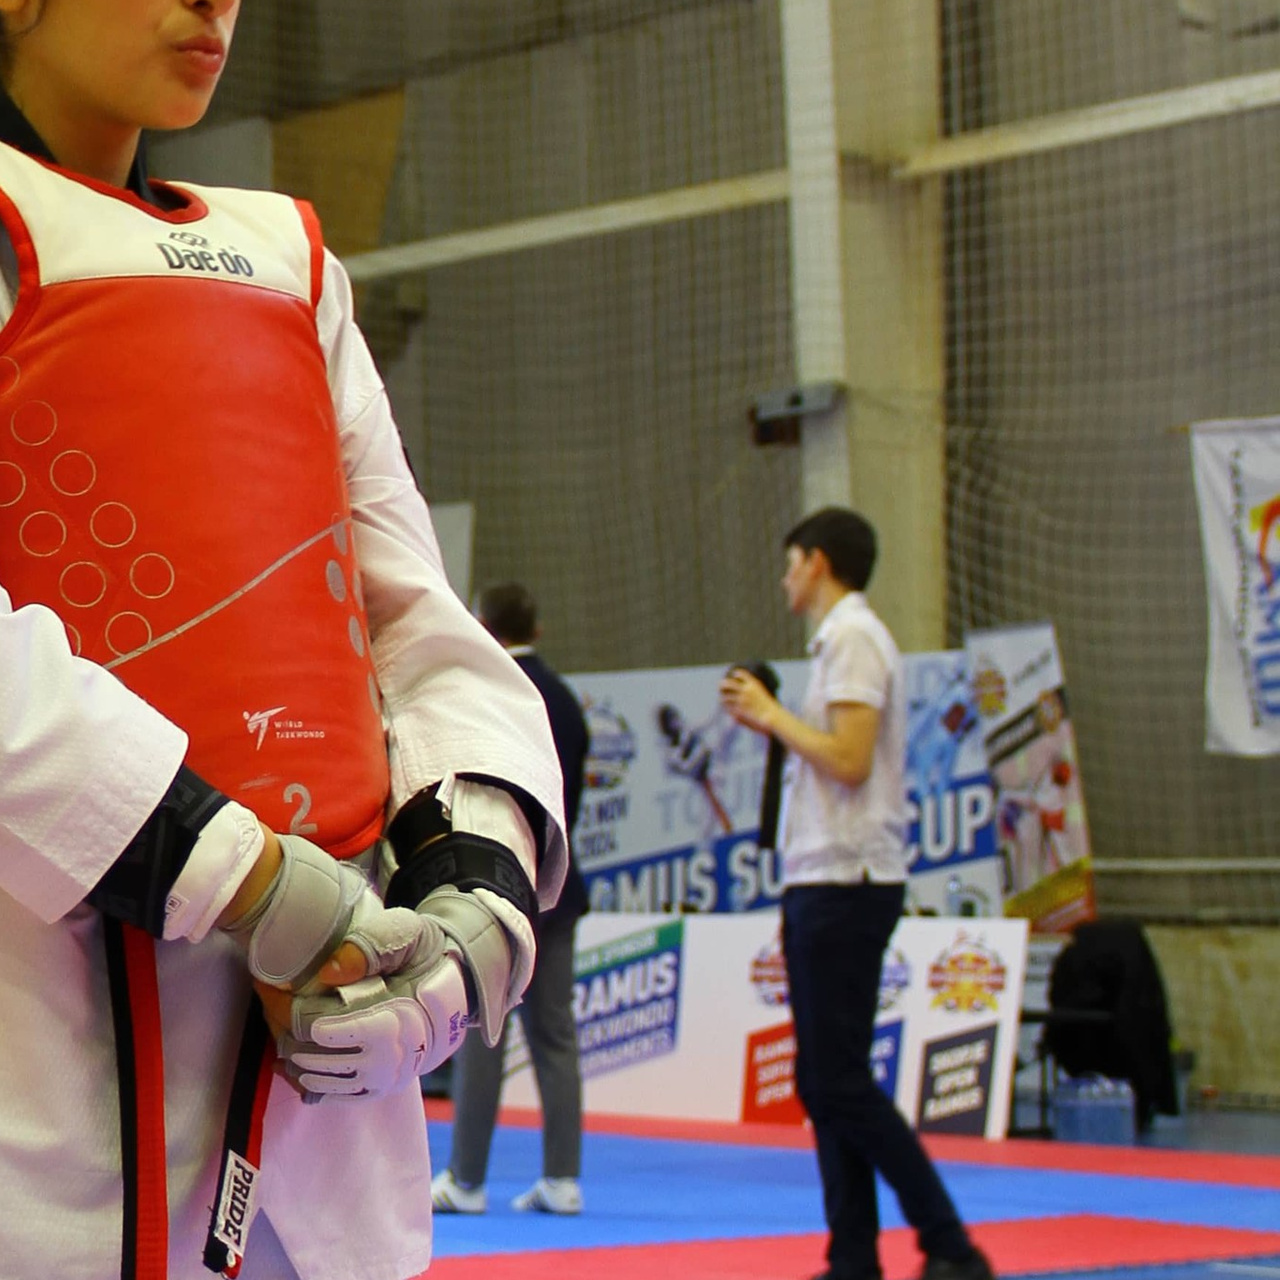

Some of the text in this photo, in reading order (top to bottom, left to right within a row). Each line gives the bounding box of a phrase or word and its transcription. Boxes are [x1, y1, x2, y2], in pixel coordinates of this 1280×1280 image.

[276, 730, 326, 739] TAEKWONDO
[283, 783, 318, 834] 2
[588, 849, 718, 913] AMUS
[223, 1159, 254, 1247] PRIDE
